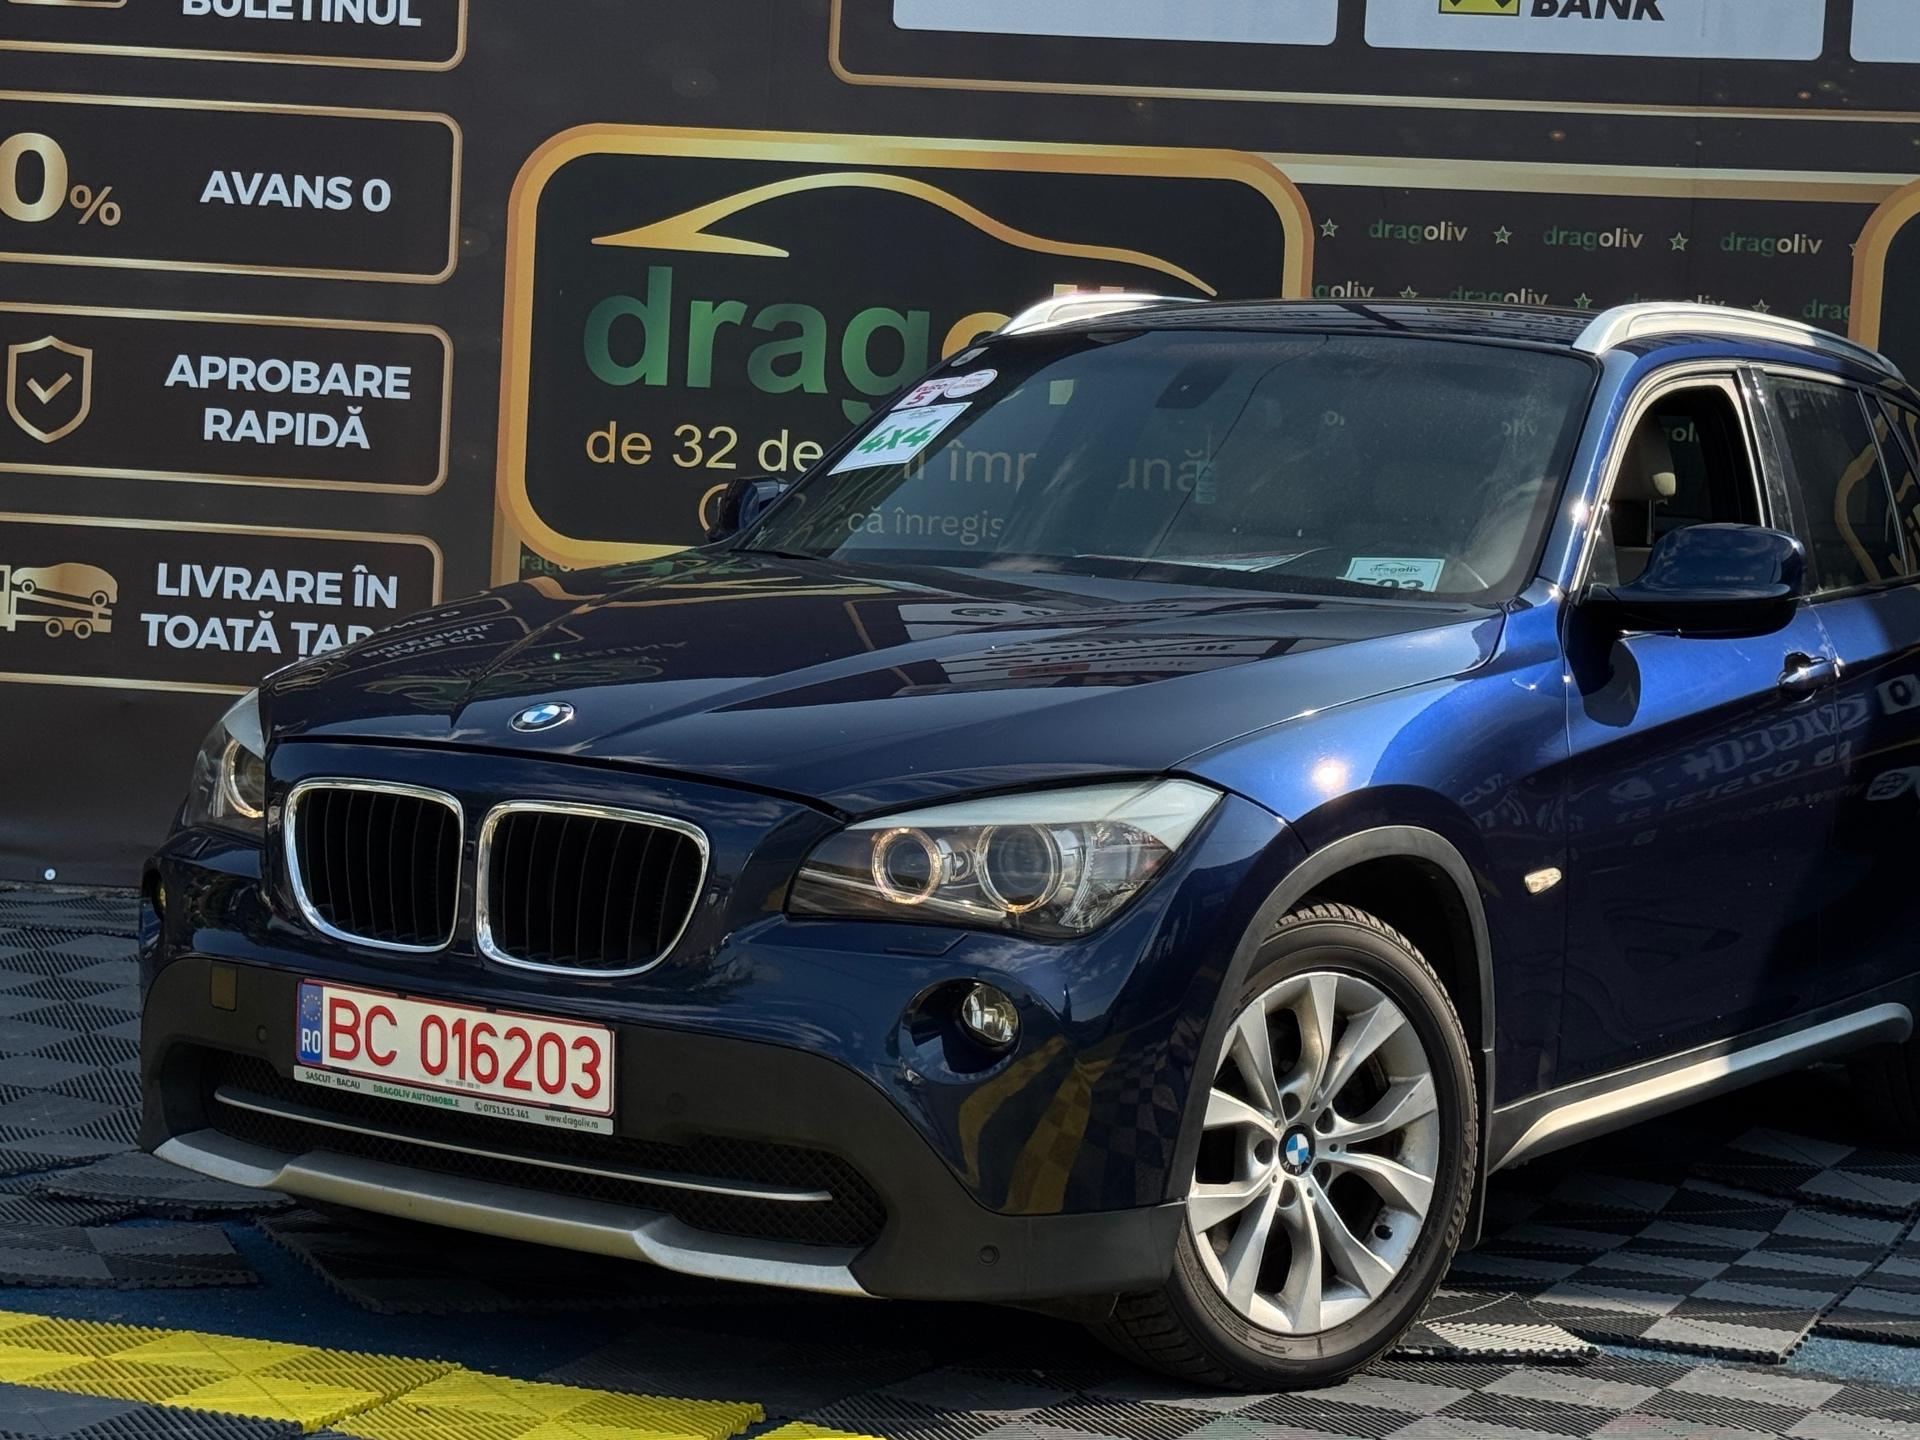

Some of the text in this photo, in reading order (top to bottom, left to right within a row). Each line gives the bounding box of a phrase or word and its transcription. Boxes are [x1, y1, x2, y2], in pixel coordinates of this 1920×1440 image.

[200, 170, 391, 213] AVANS 0
[1368, 219, 1467, 244] dragoliv
[1543, 226, 1643, 250] dragoliv
[1720, 232, 1823, 257] dragoliv
[164, 354, 411, 400] APROBARE
[203, 406, 371, 449] RAPIDĂ
[586, 420, 652, 465] de
[672, 424, 738, 470] 32
[758, 429, 824, 472] de
[157, 562, 398, 609] LIVRARE ÎN
[140, 610, 282, 654] TOATĂ
[301, 1027, 321, 1054] RO
[329, 997, 601, 1099] BC 016203
[373, 1084, 411, 1099] DRAGOLIV
[411, 1093, 460, 1107] AUTOMOBILE
